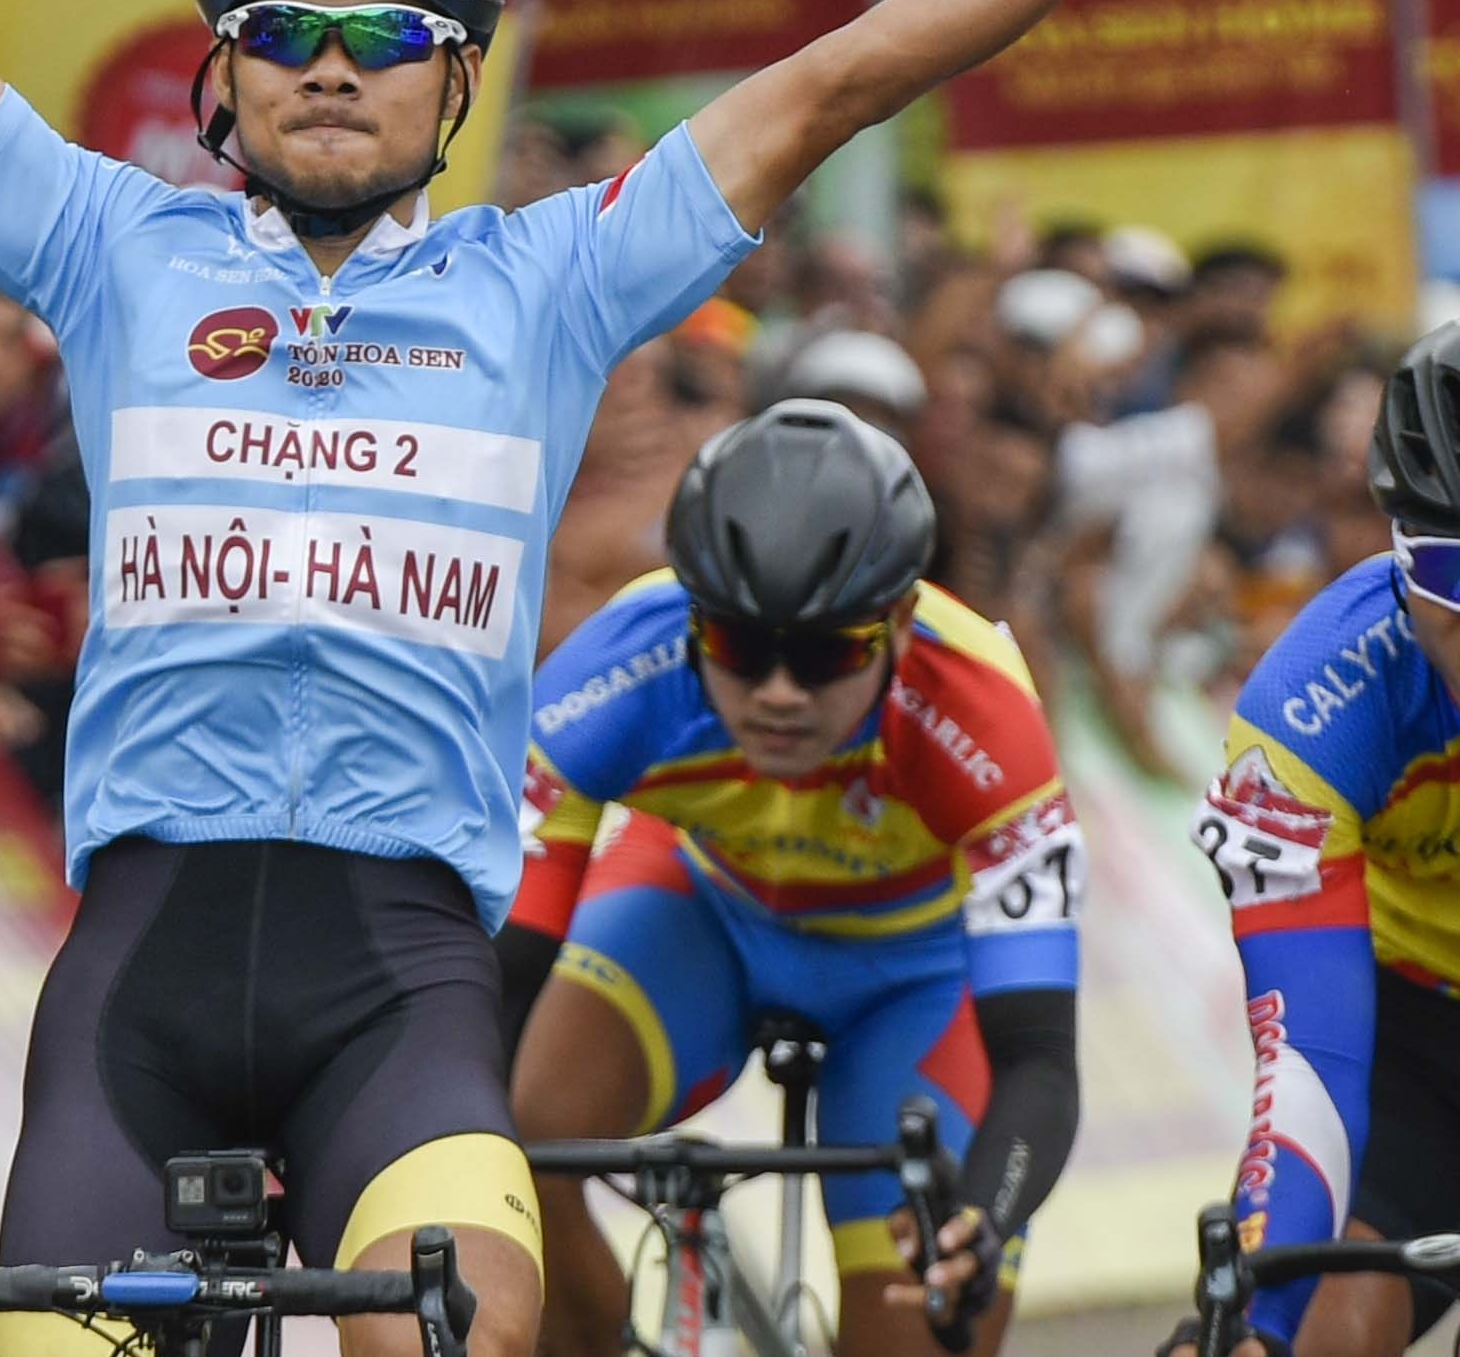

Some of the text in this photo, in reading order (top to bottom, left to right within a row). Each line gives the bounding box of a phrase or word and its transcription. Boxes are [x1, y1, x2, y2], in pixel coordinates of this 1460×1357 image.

[169, 255, 210, 280] HOA
[216, 268, 253, 283] SEN
[289, 305, 352, 336] VTV
[287, 341, 465, 370] TÔN HOA SEN
[206, 420, 419, 480] CHẶNG 2
[121, 516, 166, 603] HÀ
[306, 525, 381, 610] HÀ
[399, 549, 500, 631] NAM
[535, 635, 688, 734] DOGARLI
